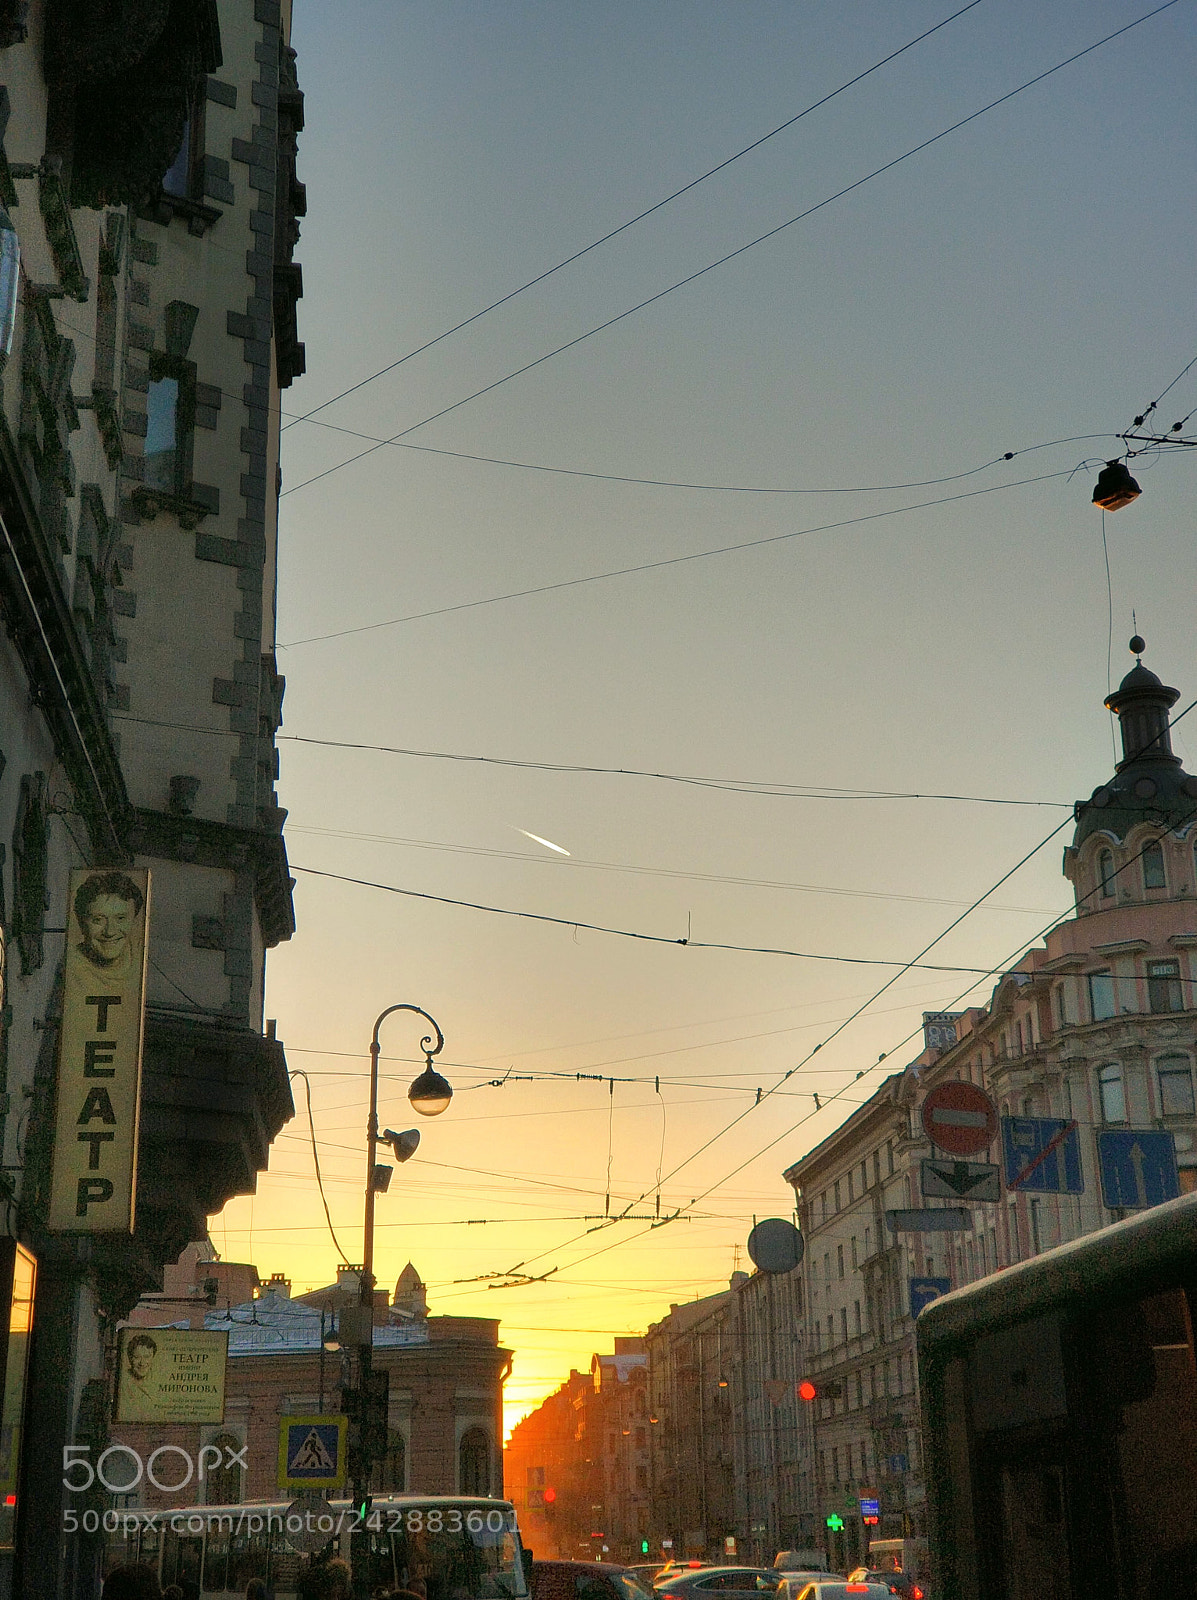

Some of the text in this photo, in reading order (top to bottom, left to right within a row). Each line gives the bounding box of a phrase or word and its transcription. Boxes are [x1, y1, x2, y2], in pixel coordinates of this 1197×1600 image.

[75, 995, 122, 1217] ТЕАТР
[172, 1353, 209, 1363] ТЕАТР
[168, 1373, 209, 1382] АНДРЕЯ
[158, 1384, 218, 1393] МИРОНОВА
